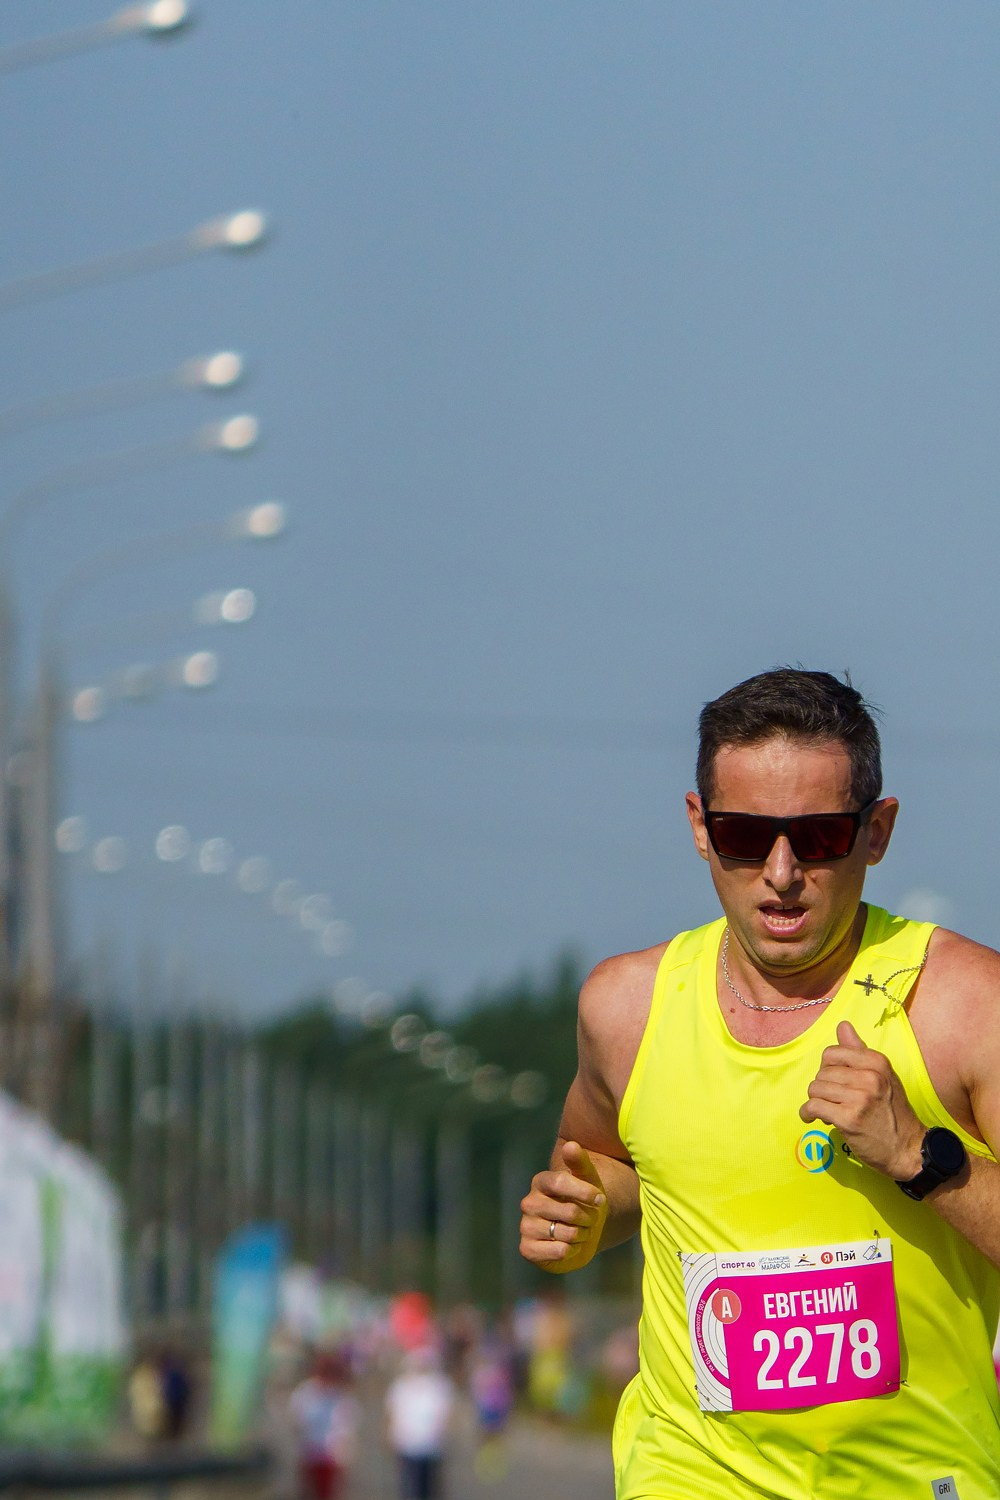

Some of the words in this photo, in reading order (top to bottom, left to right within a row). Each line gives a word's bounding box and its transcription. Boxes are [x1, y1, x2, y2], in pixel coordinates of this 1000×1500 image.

[761, 1262, 791, 1270] МАРАФОН
[835, 1250, 856, 1262] Пэй
[722, 1296, 733, 1319] А
[763, 1281, 858, 1319] ЕВГЕНИЙ
[753, 1318, 881, 1391] 2278
